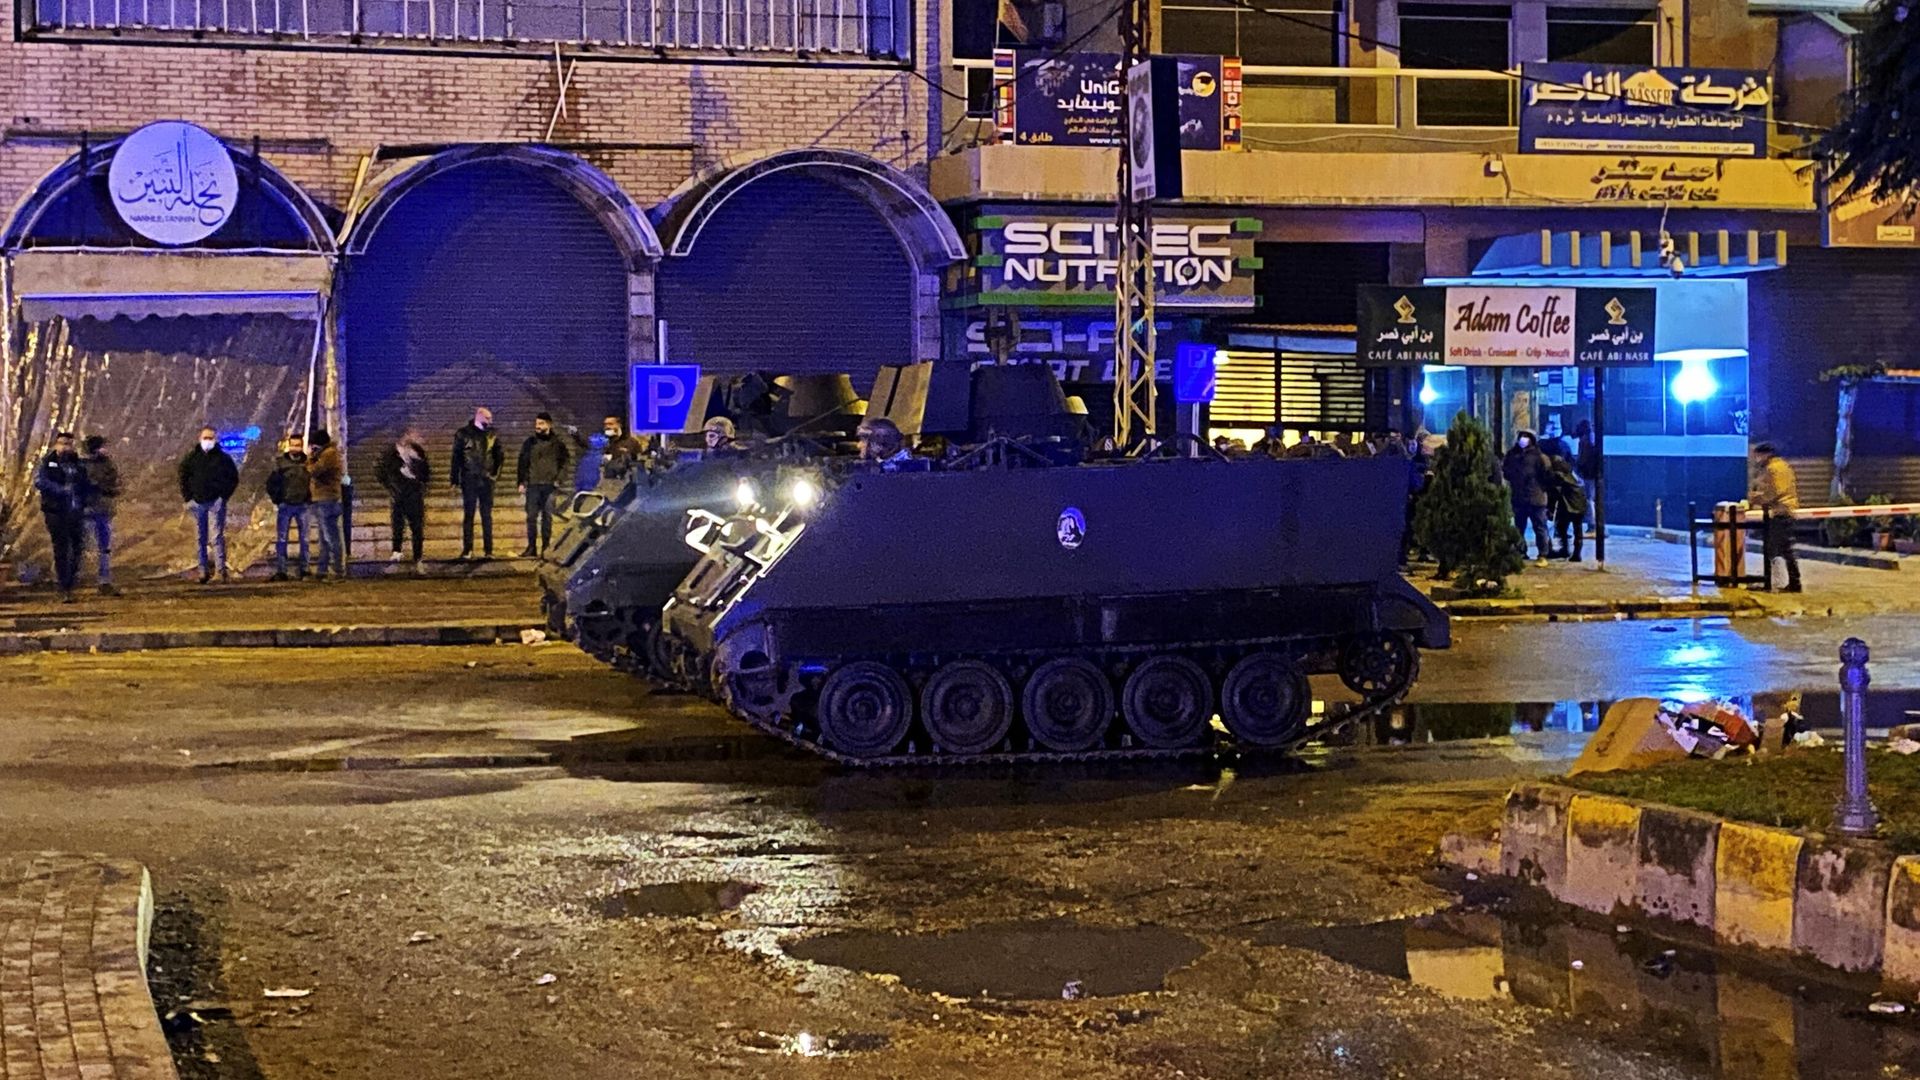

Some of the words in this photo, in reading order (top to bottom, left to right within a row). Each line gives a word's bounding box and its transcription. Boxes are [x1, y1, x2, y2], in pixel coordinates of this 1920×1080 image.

[1080, 79, 1120, 95] UniG
[1528, 71, 1621, 106] الناصر
[1681, 75, 1769, 111] شركة
[1628, 88, 1671, 105] NASSER
[1581, 110, 1616, 124] العامة
[1660, 113, 1700, 129] العقارية
[1019, 131, 1027, 142] 4
[1028, 131, 1054, 144] طابق
[1453, 295, 1511, 333] Adam
[1516, 295, 1570, 338] Coffee
[1376, 327, 1399, 342] نصر
[1401, 325, 1419, 345] أبي
[1419, 329, 1434, 343] بن
[1588, 328, 1611, 344] نصر
[1612, 326, 1629, 346] أبي
[1629, 330, 1644, 344] بن
[1368, 348, 1393, 360] CAFÉ
[1396, 351, 1413, 361] ABI
[1415, 351, 1441, 361] NASR
[1579, 349, 1604, 361] CAFÉ
[1607, 351, 1623, 361] ABI
[1625, 351, 1649, 361] NASR
[1102, 358, 1173, 381] LIE
[648, 374, 685, 423] P
